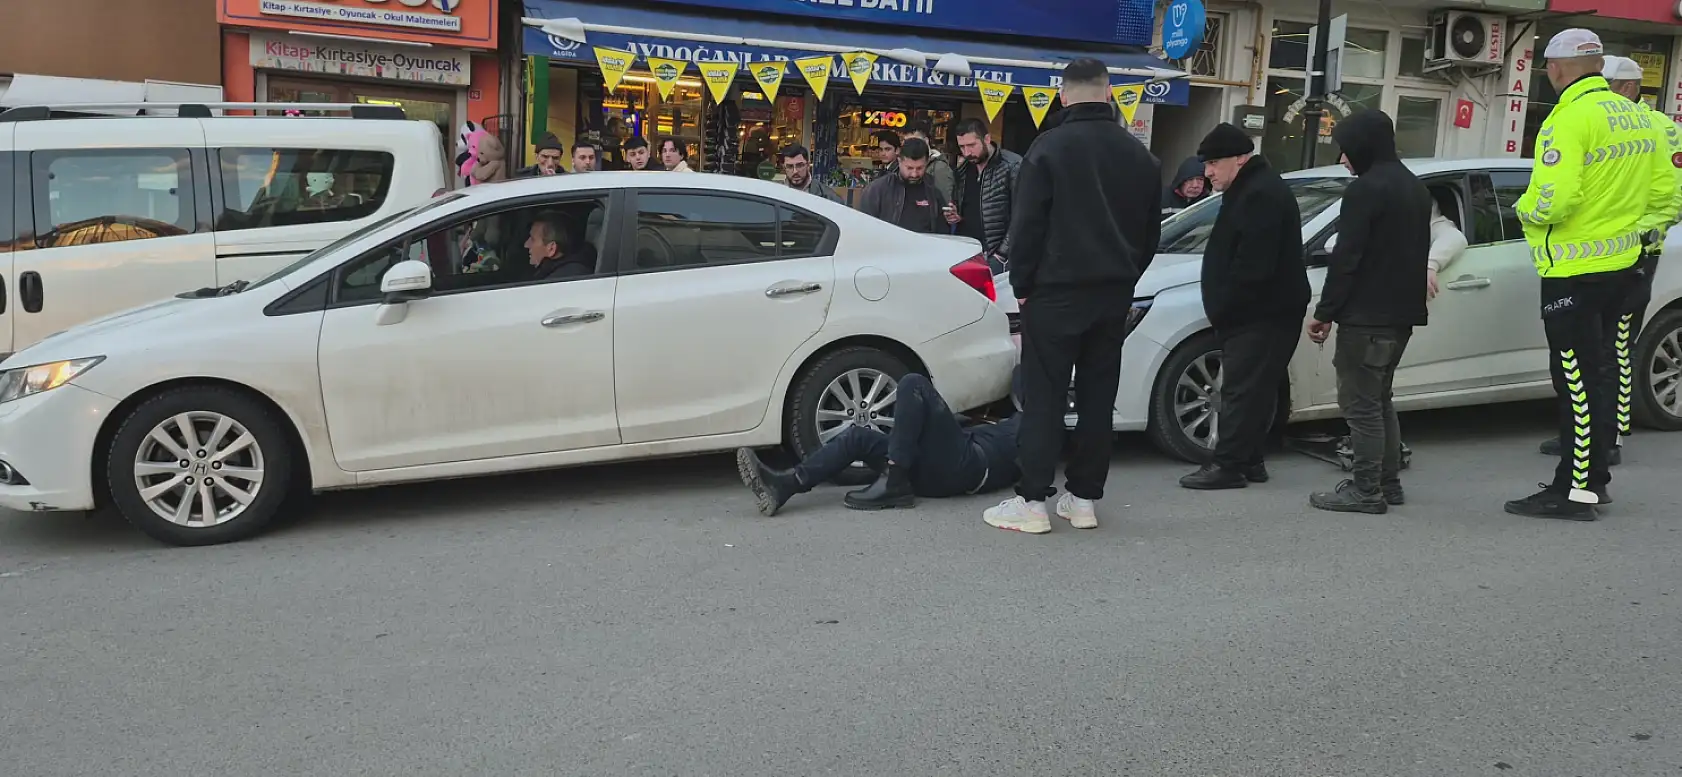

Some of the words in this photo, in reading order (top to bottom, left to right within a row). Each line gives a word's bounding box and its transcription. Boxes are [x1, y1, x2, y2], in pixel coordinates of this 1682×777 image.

[263, 1, 285, 11] Kitap
[340, 8, 376, 20] Oyuncak
[383, 12, 404, 22] Okul
[406, 15, 457, 27] Malzemeleri
[1489, 23, 1499, 59] VESTEL
[829, 59, 1014, 88] MRKET&TEKEL
[863, 110, 908, 128] %100
